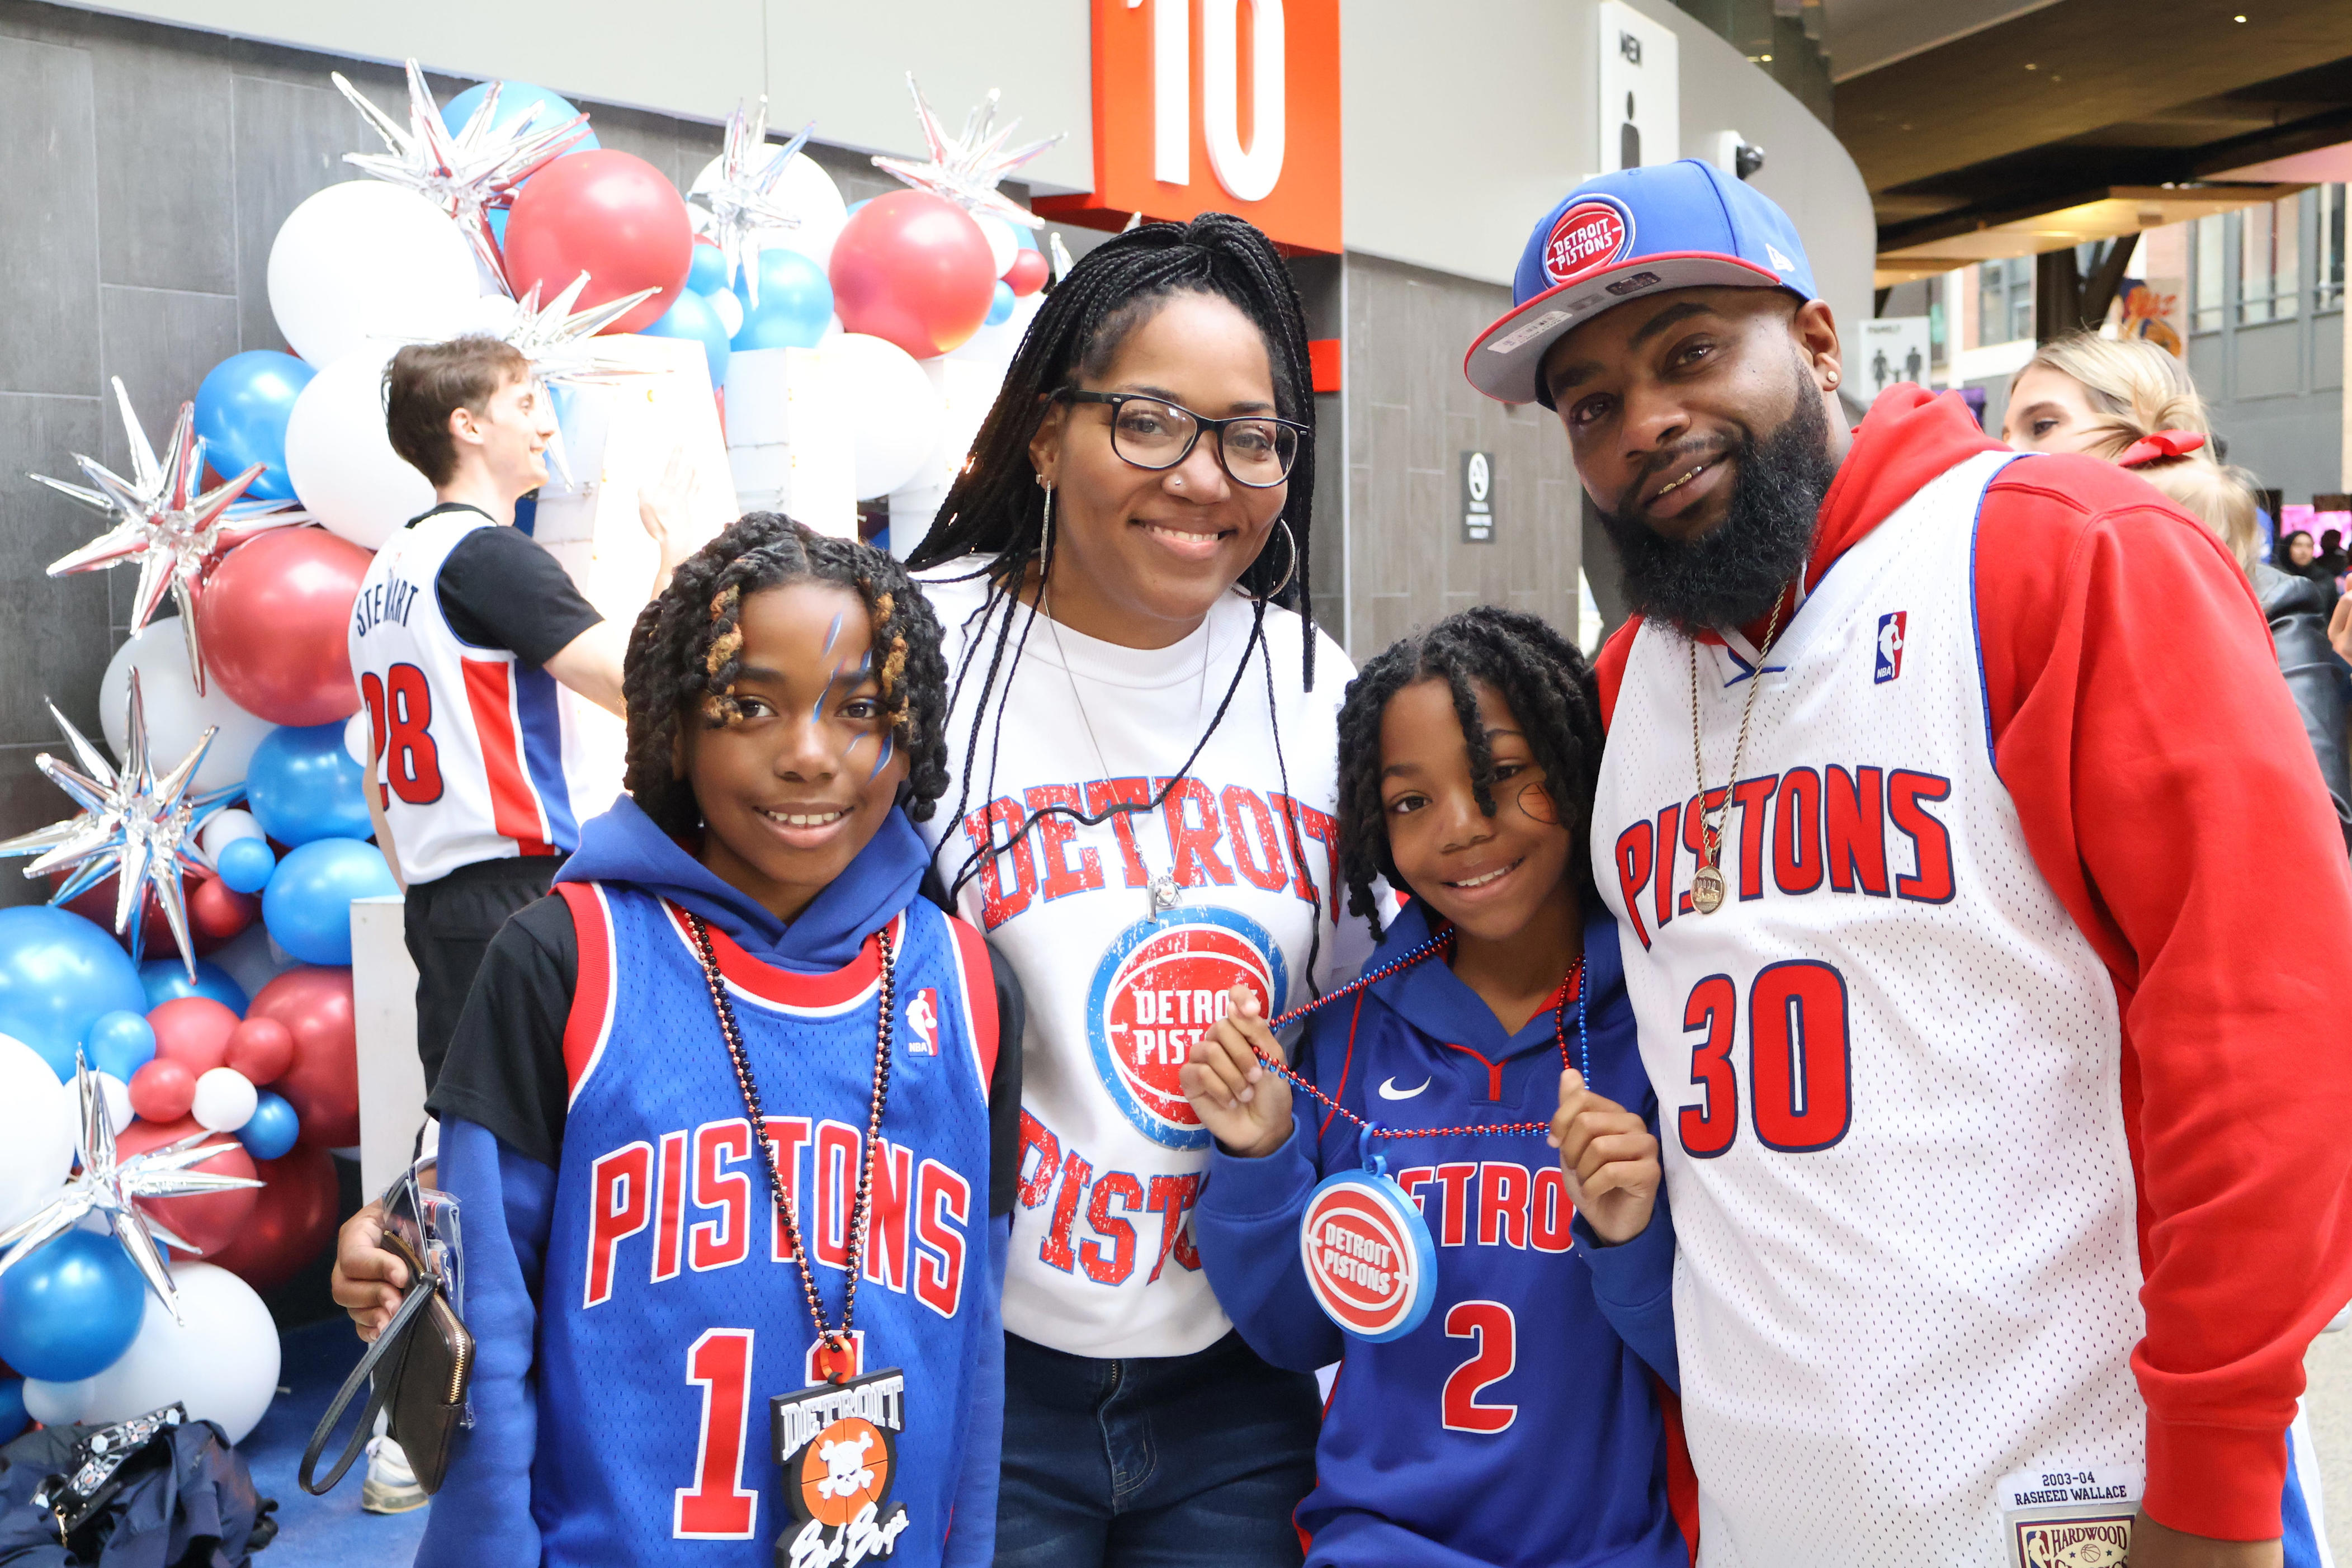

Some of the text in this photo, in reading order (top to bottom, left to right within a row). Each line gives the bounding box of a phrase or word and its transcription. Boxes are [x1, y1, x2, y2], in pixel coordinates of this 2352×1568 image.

[1126, 0, 1285, 201] 10
[1553, 218, 1609, 257] DETROIT
[1555, 232, 1613, 271] PISTONS
[1877, 665, 1891, 679] NBA
[1615, 763, 1956, 953] PISTONS
[1132, 990, 1258, 1024] DETRO
[909, 1042, 928, 1052] NBA
[1678, 959, 1853, 1160] 30
[583, 1116, 971, 1319] PISTONS
[1325, 1222, 1391, 1269] DETROIT
[1324, 1248, 1391, 1296] PISTONS
[1442, 1300, 1518, 1434] 2
[781, 1375, 904, 1461] DETROIT
[2015, 1485, 2127, 1505] RASHEED WALLACE
[2042, 1471, 2095, 1486] 2003-04
[2051, 1526, 2127, 1558] HARDWOOD
